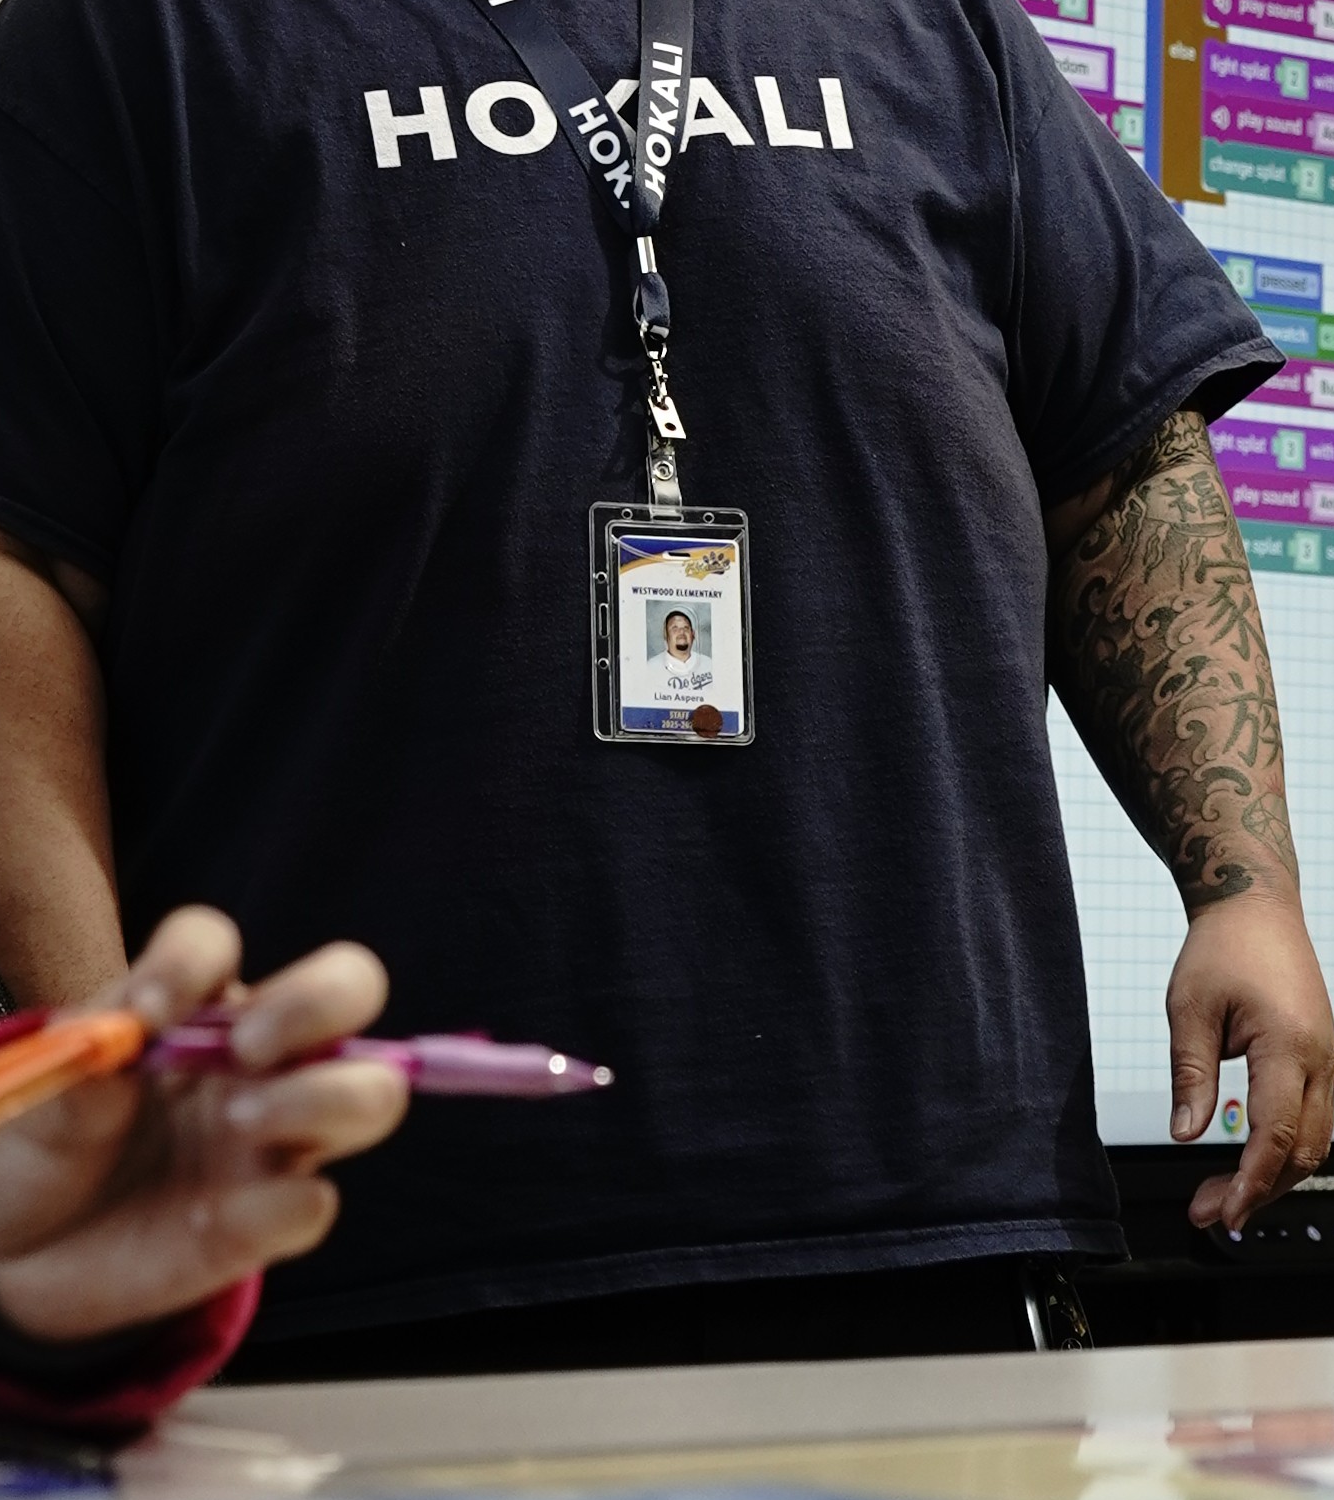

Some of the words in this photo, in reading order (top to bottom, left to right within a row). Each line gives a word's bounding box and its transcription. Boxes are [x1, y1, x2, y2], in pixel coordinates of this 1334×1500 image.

[1267, 2, 1304, 22] sound
[1210, 55, 1238, 77] light
[1240, 60, 1271, 82] splat
[645, 42, 683, 200] HOKALI
[1237, 110, 1264, 134] play
[1265, 116, 1303, 136] sound
[568, 98, 634, 209] HOK
[1208, 154, 1253, 180] change
[1254, 161, 1286, 184] splat
[1260, 273, 1308, 293] pressed
[1235, 435, 1267, 455] splat
[1233, 483, 1260, 507] play
[1261, 489, 1300, 507] sound
[631, 586, 674, 597] WESTWOOD
[676, 588, 722, 599] ELEMENTARY
[654, 692, 672, 701] Lian
[674, 693, 704, 703] Aspera
[669, 710, 689, 719] STAFF
